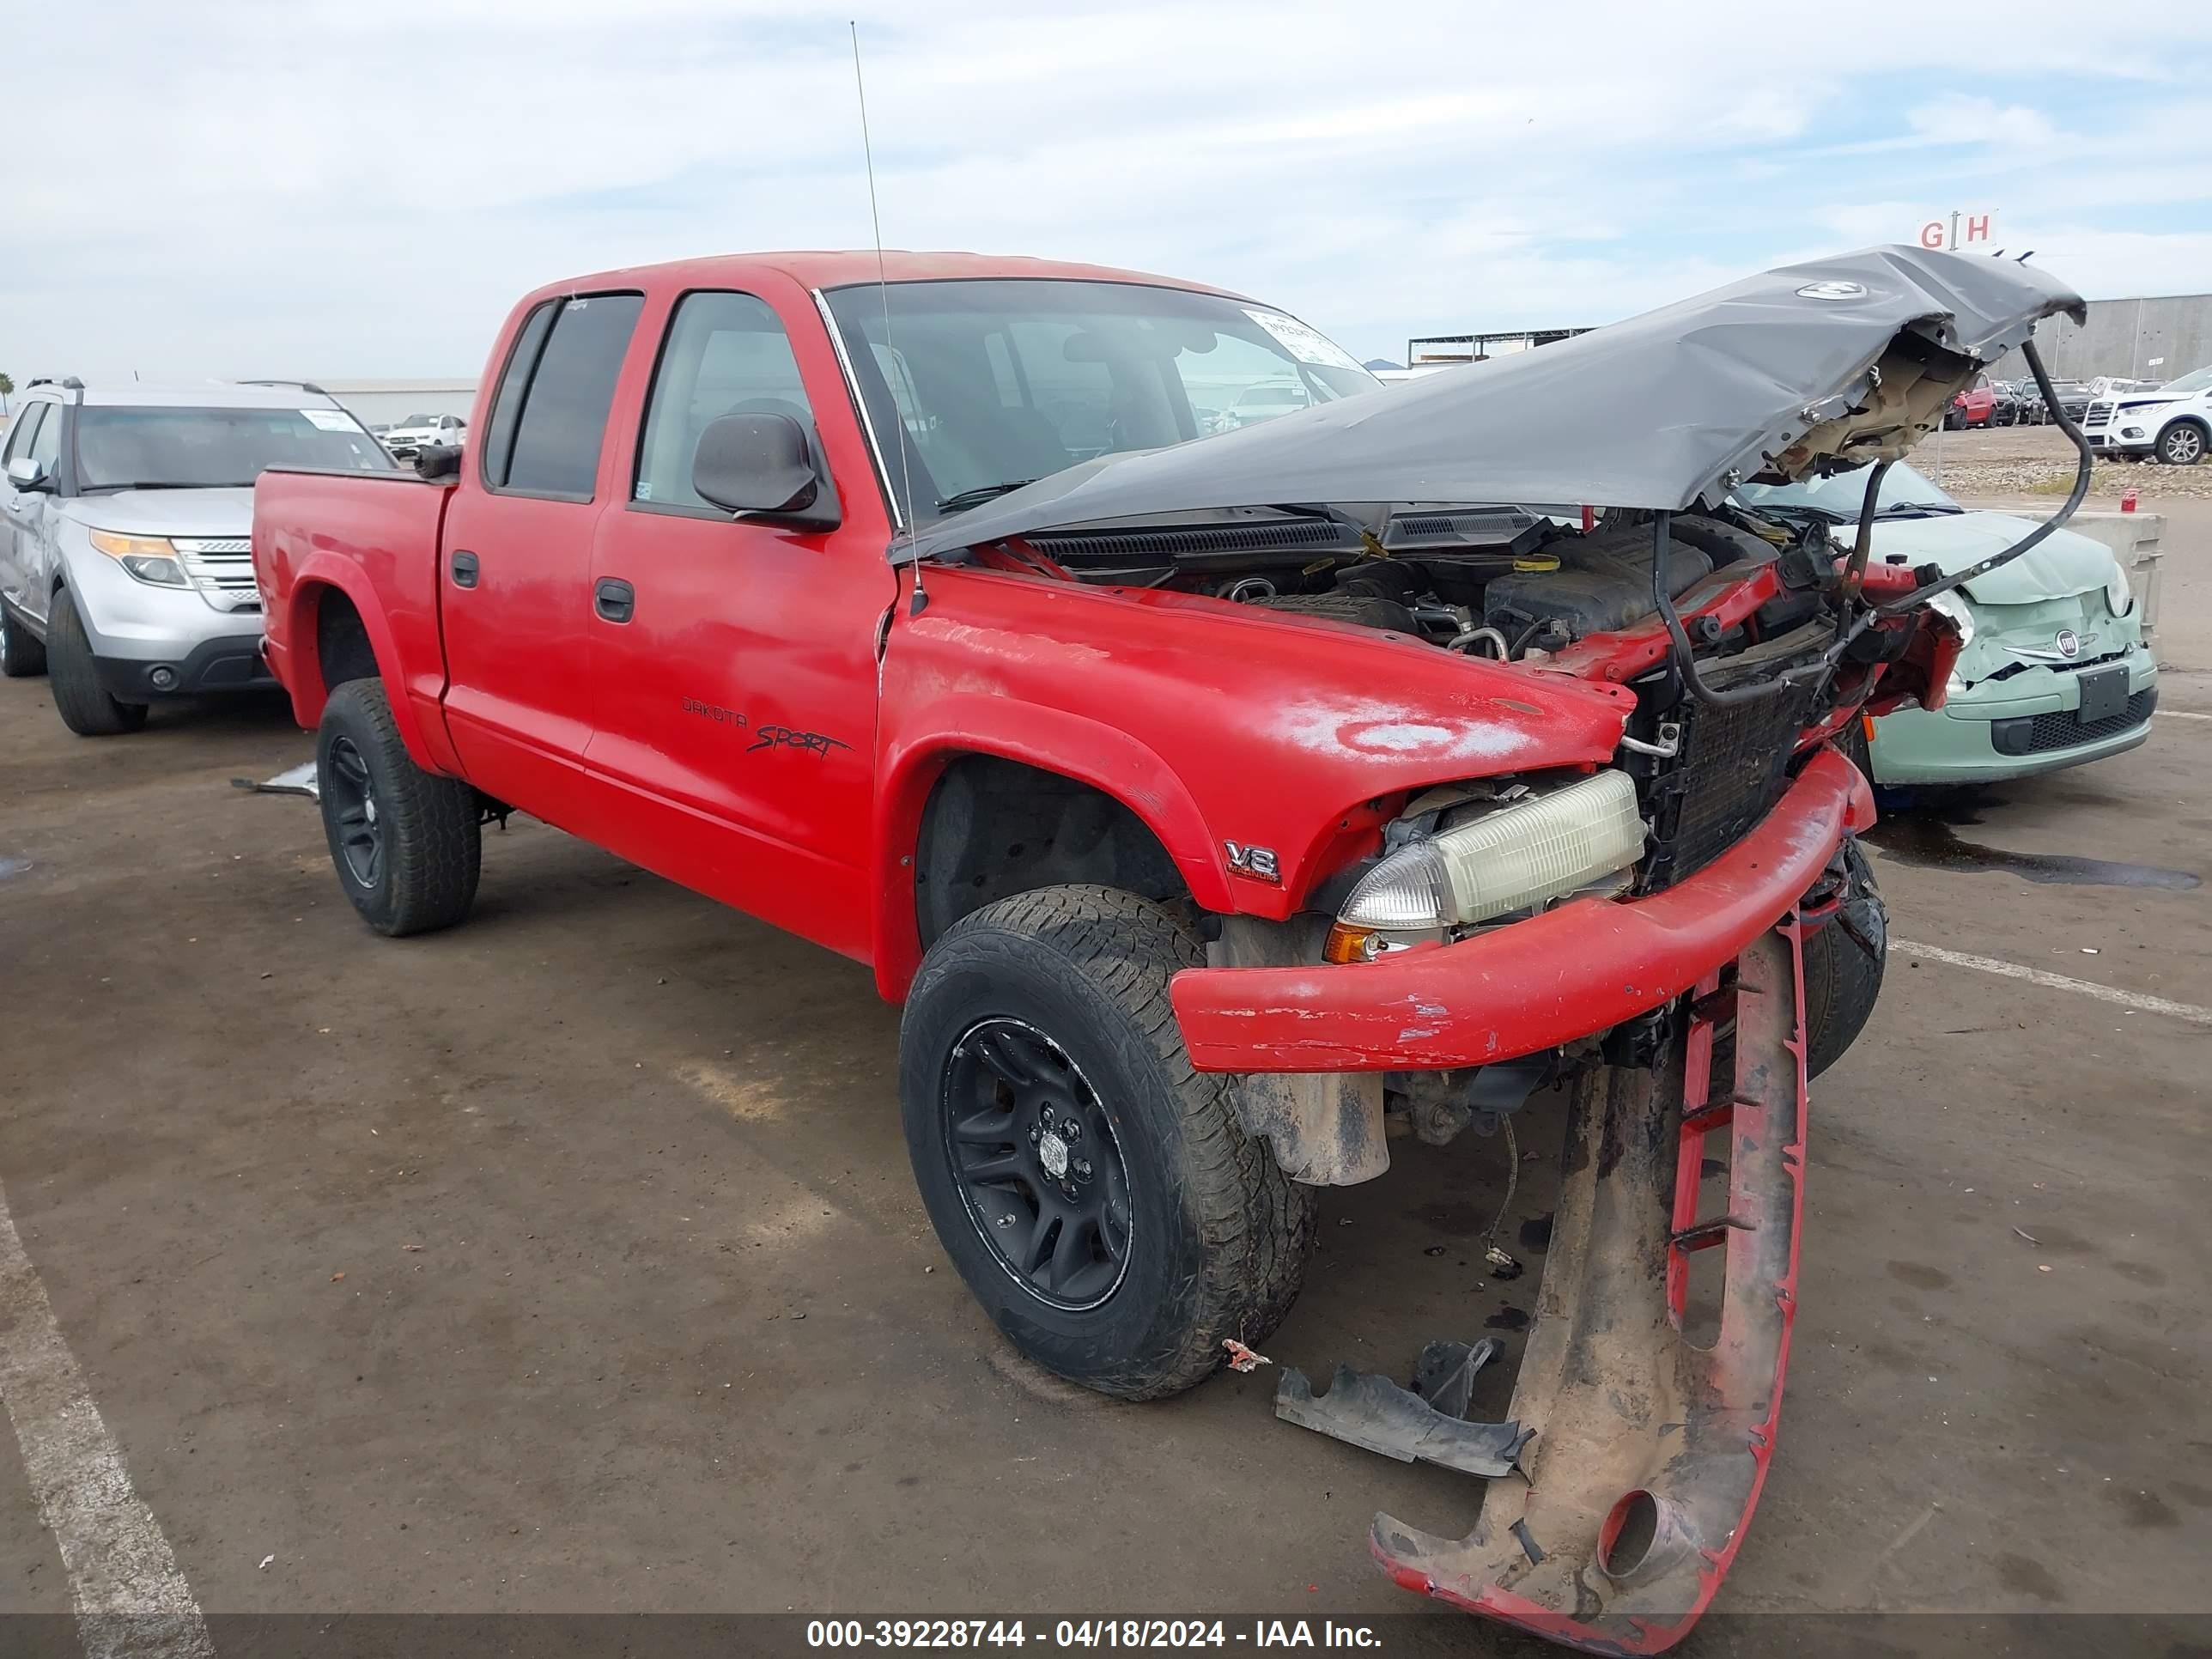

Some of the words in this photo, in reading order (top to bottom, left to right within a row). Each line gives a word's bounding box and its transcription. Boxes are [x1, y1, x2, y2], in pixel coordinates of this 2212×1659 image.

[1921, 222, 1943, 248] G
[1967, 216, 1989, 241] H
[681, 696, 747, 728] DAKOTA
[746, 725, 859, 763] SPORT
[1224, 841, 1277, 875] V8
